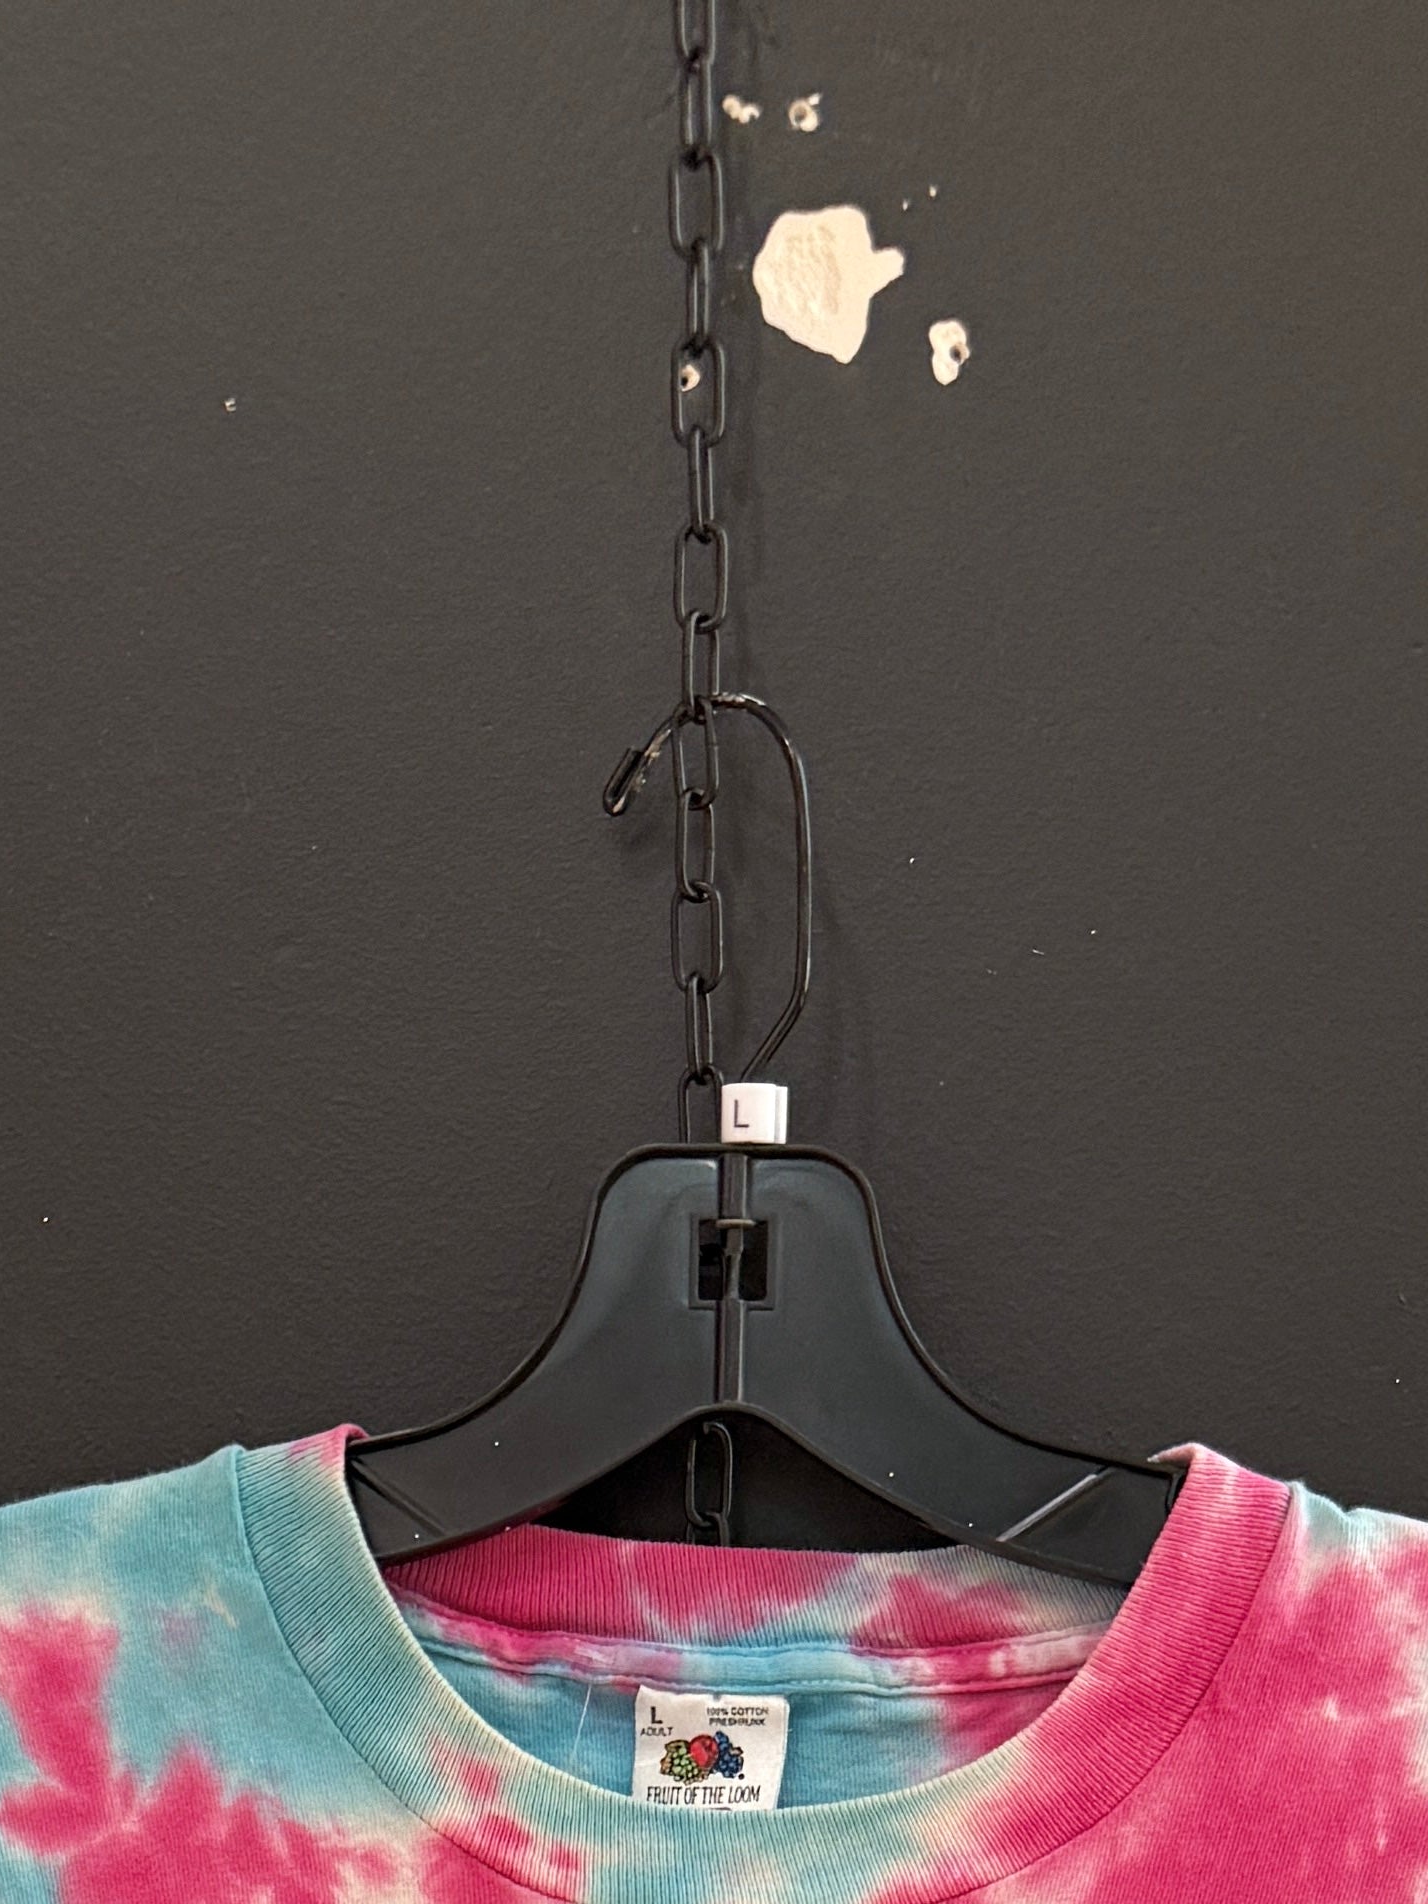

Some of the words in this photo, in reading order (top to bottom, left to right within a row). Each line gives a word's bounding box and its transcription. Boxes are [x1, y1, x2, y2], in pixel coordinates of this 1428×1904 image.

[734, 1099, 750, 1128] L
[650, 1706, 663, 1724] L
[731, 1706, 770, 1716] COTTON
[640, 1726, 673, 1737] ADULT
[647, 1786, 682, 1805] FRUIT
[684, 1786, 699, 1805] OF
[700, 1786, 726, 1805] THE
[728, 1785, 761, 1804] LOOM
